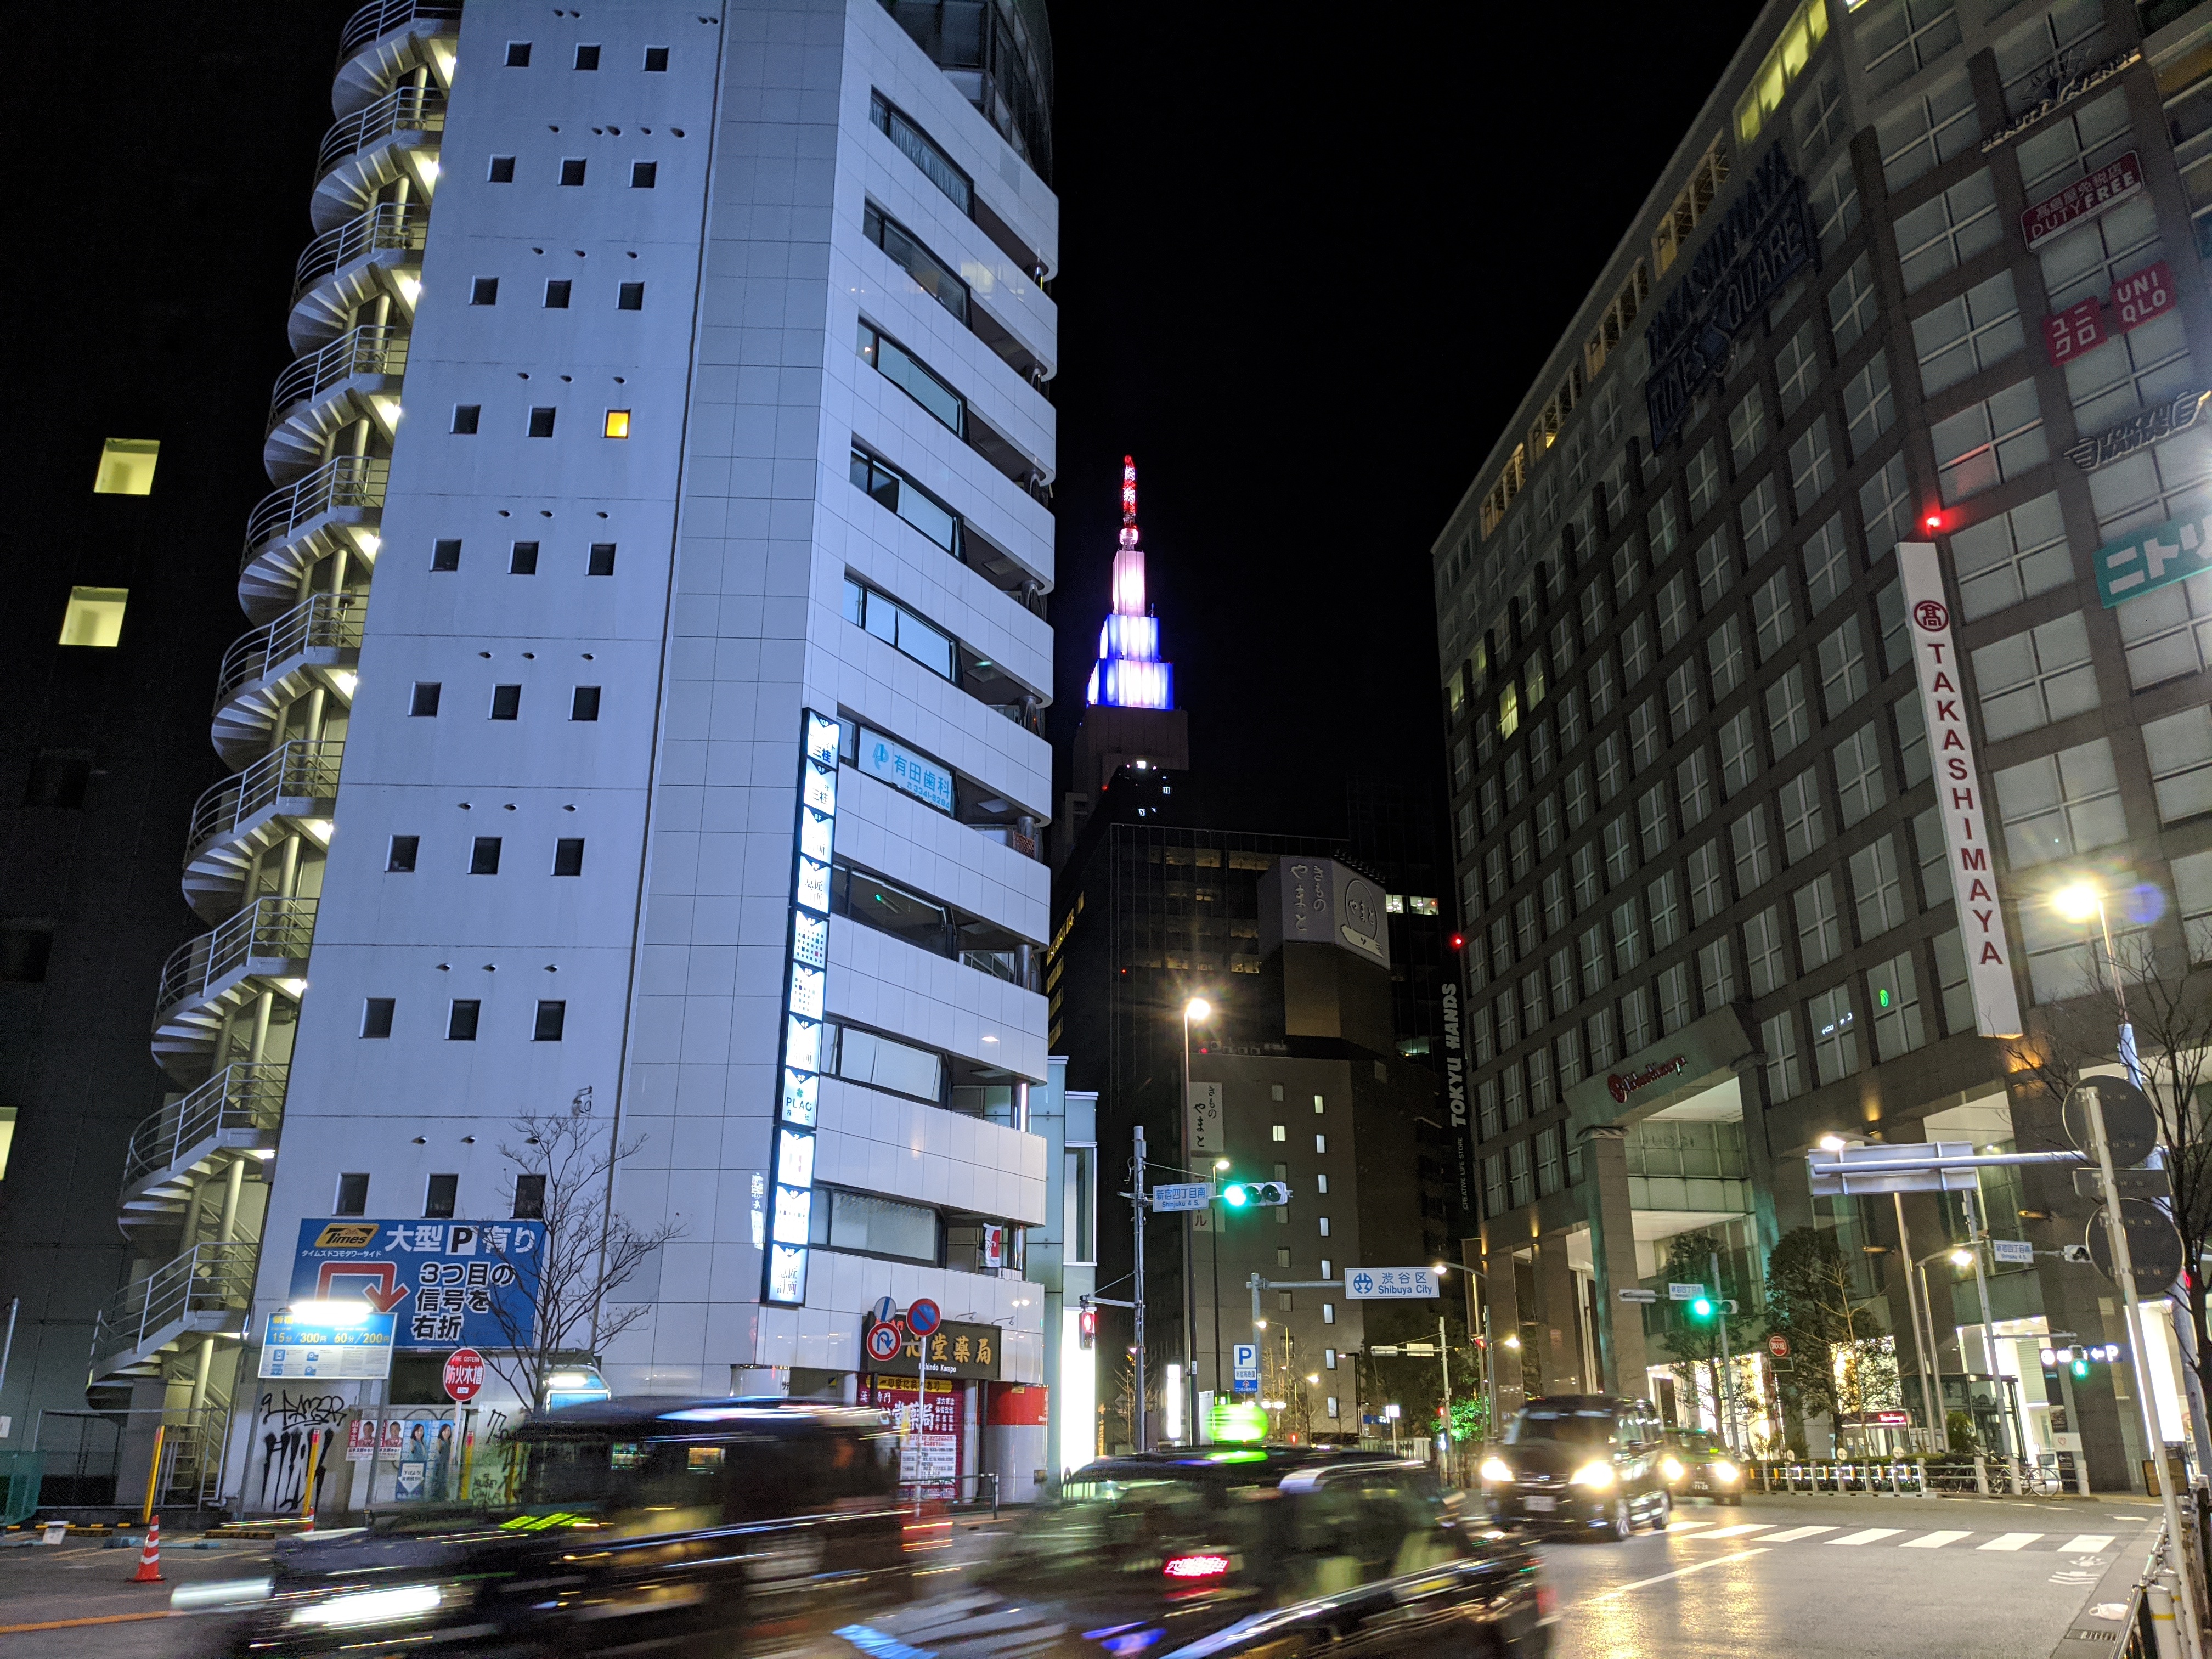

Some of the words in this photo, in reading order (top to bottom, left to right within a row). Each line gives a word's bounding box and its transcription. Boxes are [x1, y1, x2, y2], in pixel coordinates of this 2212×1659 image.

[2117, 271, 2158, 302] UNI
[2052, 305, 2092, 338] ユニ
[2121, 289, 2167, 323] QLO
[2056, 324, 2097, 357] クロ
[894, 755, 949, 799] 有田歯科
[1927, 644, 2004, 965] TAKASHIMAYA
[1290, 864, 1308, 932] やまと
[1442, 984, 1460, 1049] HANDS
[1447, 1057, 1466, 1127] TOKYU
[1193, 1102, 1206, 1147] やまと
[1457, 1158, 1465, 1175] LIFE
[1156, 1187, 1205, 1200] 新宿四丁目南
[1458, 1177, 1469, 1210] CREATIVE
[325, 1232, 368, 1245] Times
[385, 1224, 535, 1256] 大型P有り
[419, 1261, 516, 1288] 3つ目の
[1378, 1285, 1412, 1295] Shibuya
[1416, 1285, 1432, 1295] City
[1382, 1272, 1427, 1284] 渋谷区
[415, 1286, 491, 1314] 信号を
[411, 1312, 465, 1342] 右折
[940, 1364, 957, 1373] Kampo
[1239, 1347, 1252, 1365] P
[2106, 1345, 2118, 1362] P
